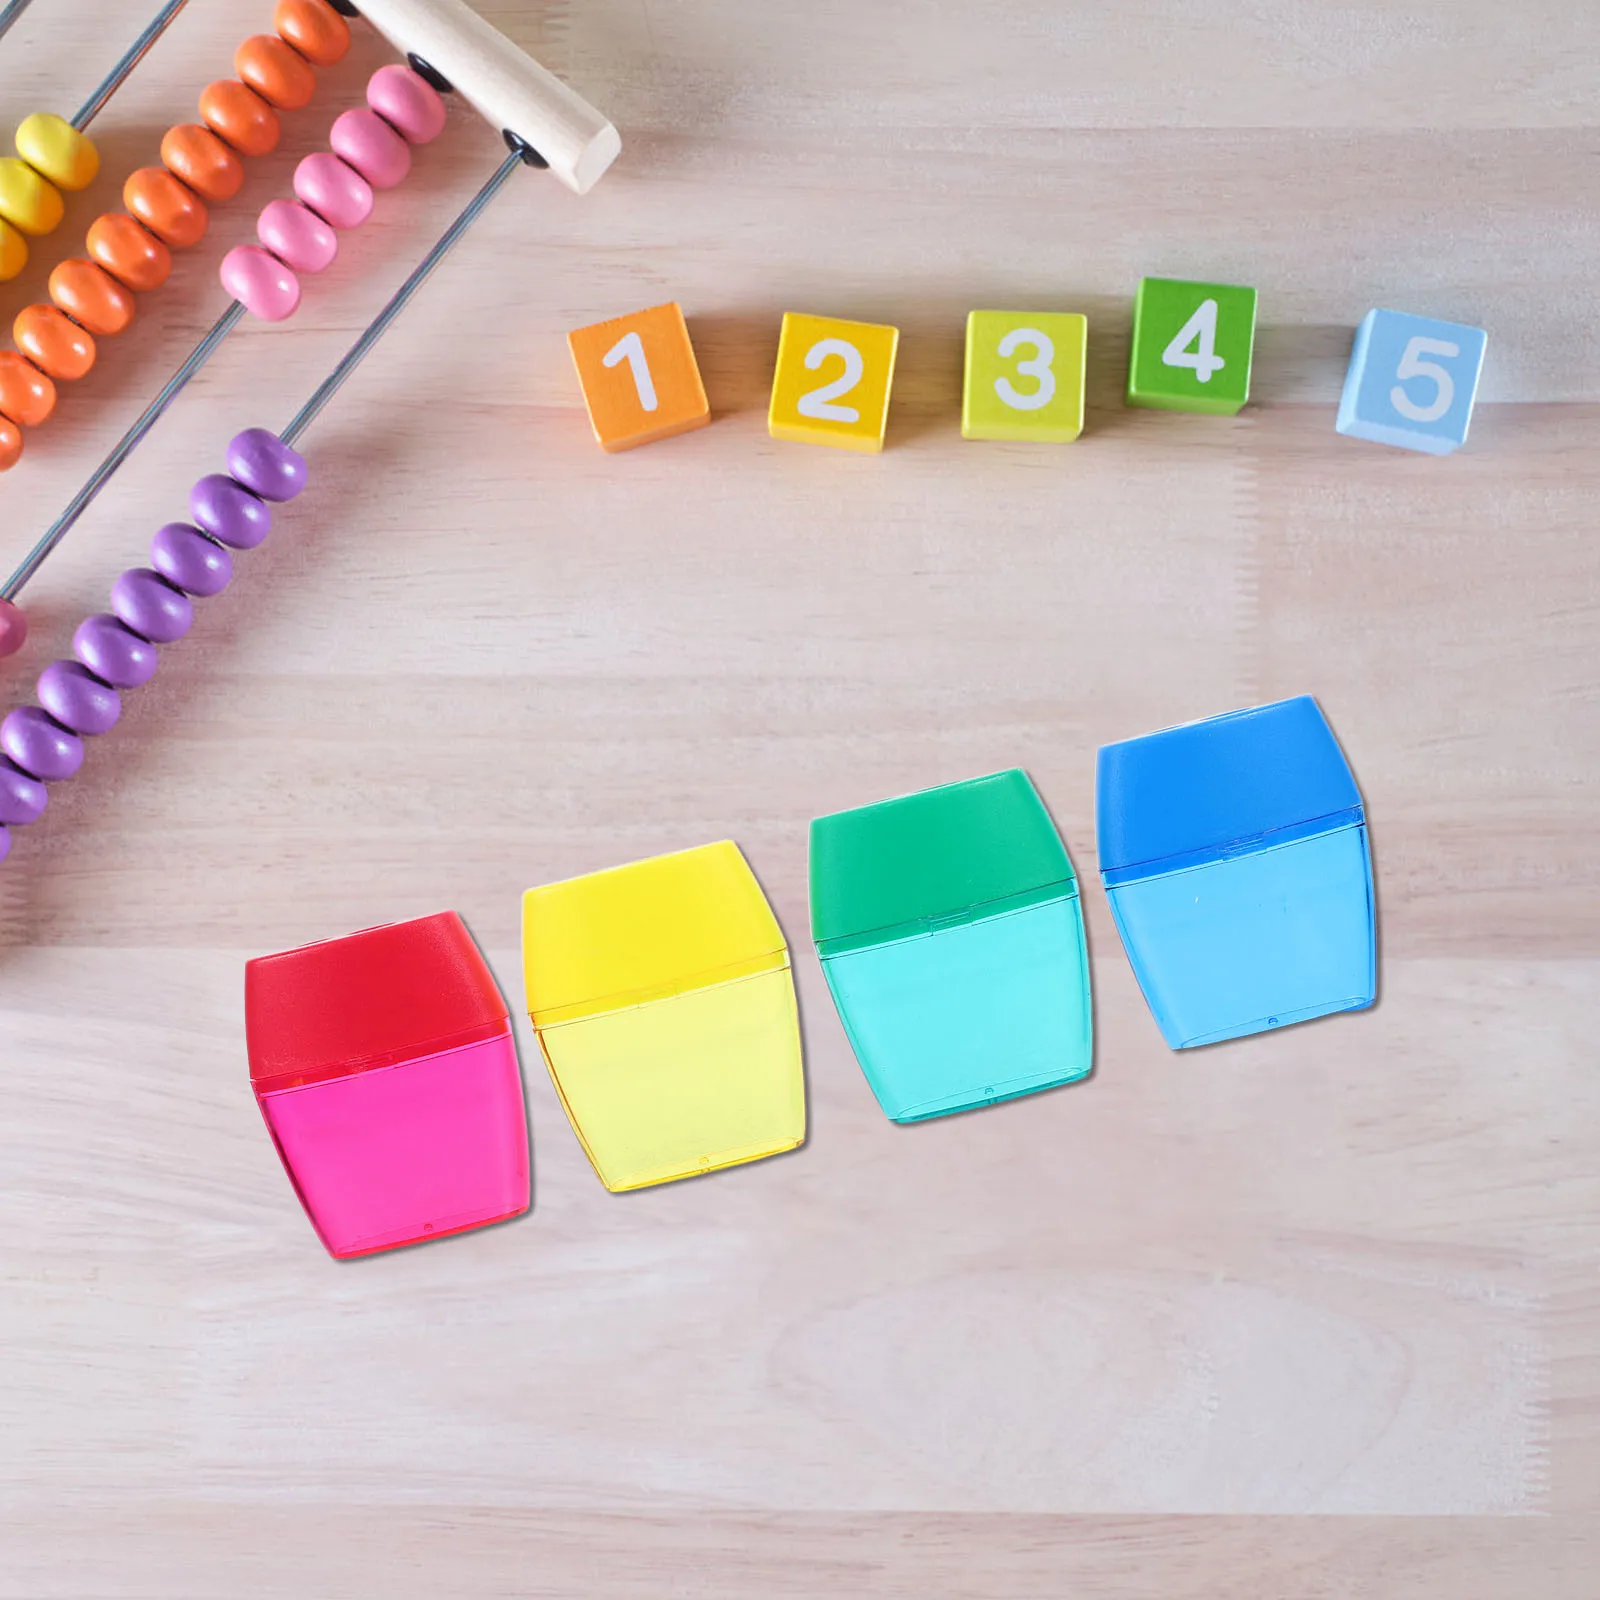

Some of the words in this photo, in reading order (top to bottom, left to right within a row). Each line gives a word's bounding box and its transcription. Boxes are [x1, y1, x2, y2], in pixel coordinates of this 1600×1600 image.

[602, 332, 658, 412] 1
[797, 338, 863, 423] 2
[994, 327, 1056, 411] 3
[1162, 299, 1225, 383] 4
[1390, 336, 1460, 423] 5
